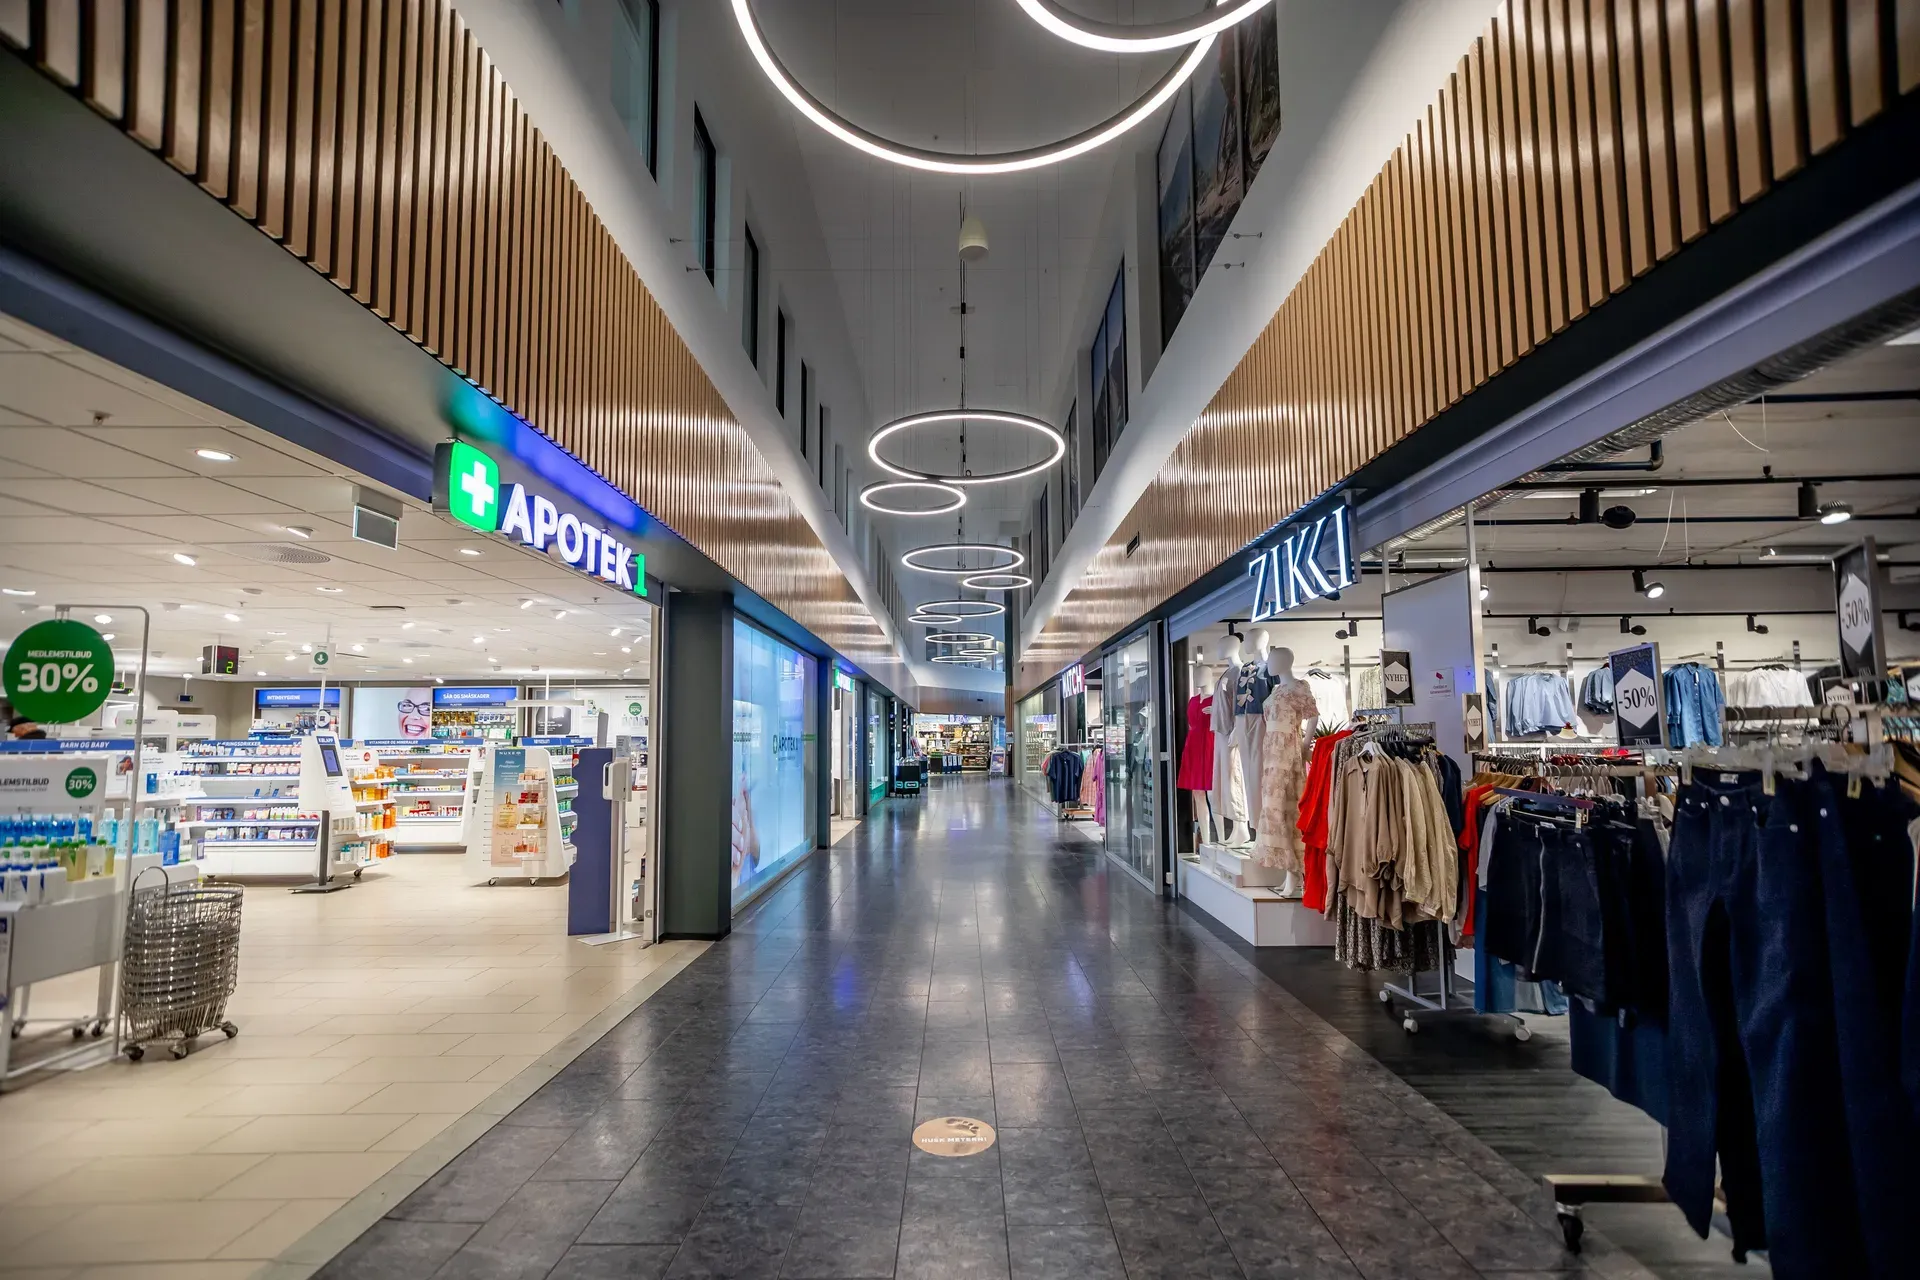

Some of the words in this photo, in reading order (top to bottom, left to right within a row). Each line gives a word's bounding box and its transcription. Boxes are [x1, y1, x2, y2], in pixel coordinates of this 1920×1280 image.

[1249, 505, 1352, 623] ZIKKI
[1842, 596, 1870, 629] -50%
[27, 650, 92, 659] MEDLEMSTILBUD
[226, 661, 234, 674] 2
[17, 662, 98, 693] 30%
[1385, 673, 1408, 682] NYHET
[1619, 686, 1655, 709] -50%
[68, 779, 93, 790] 30%
